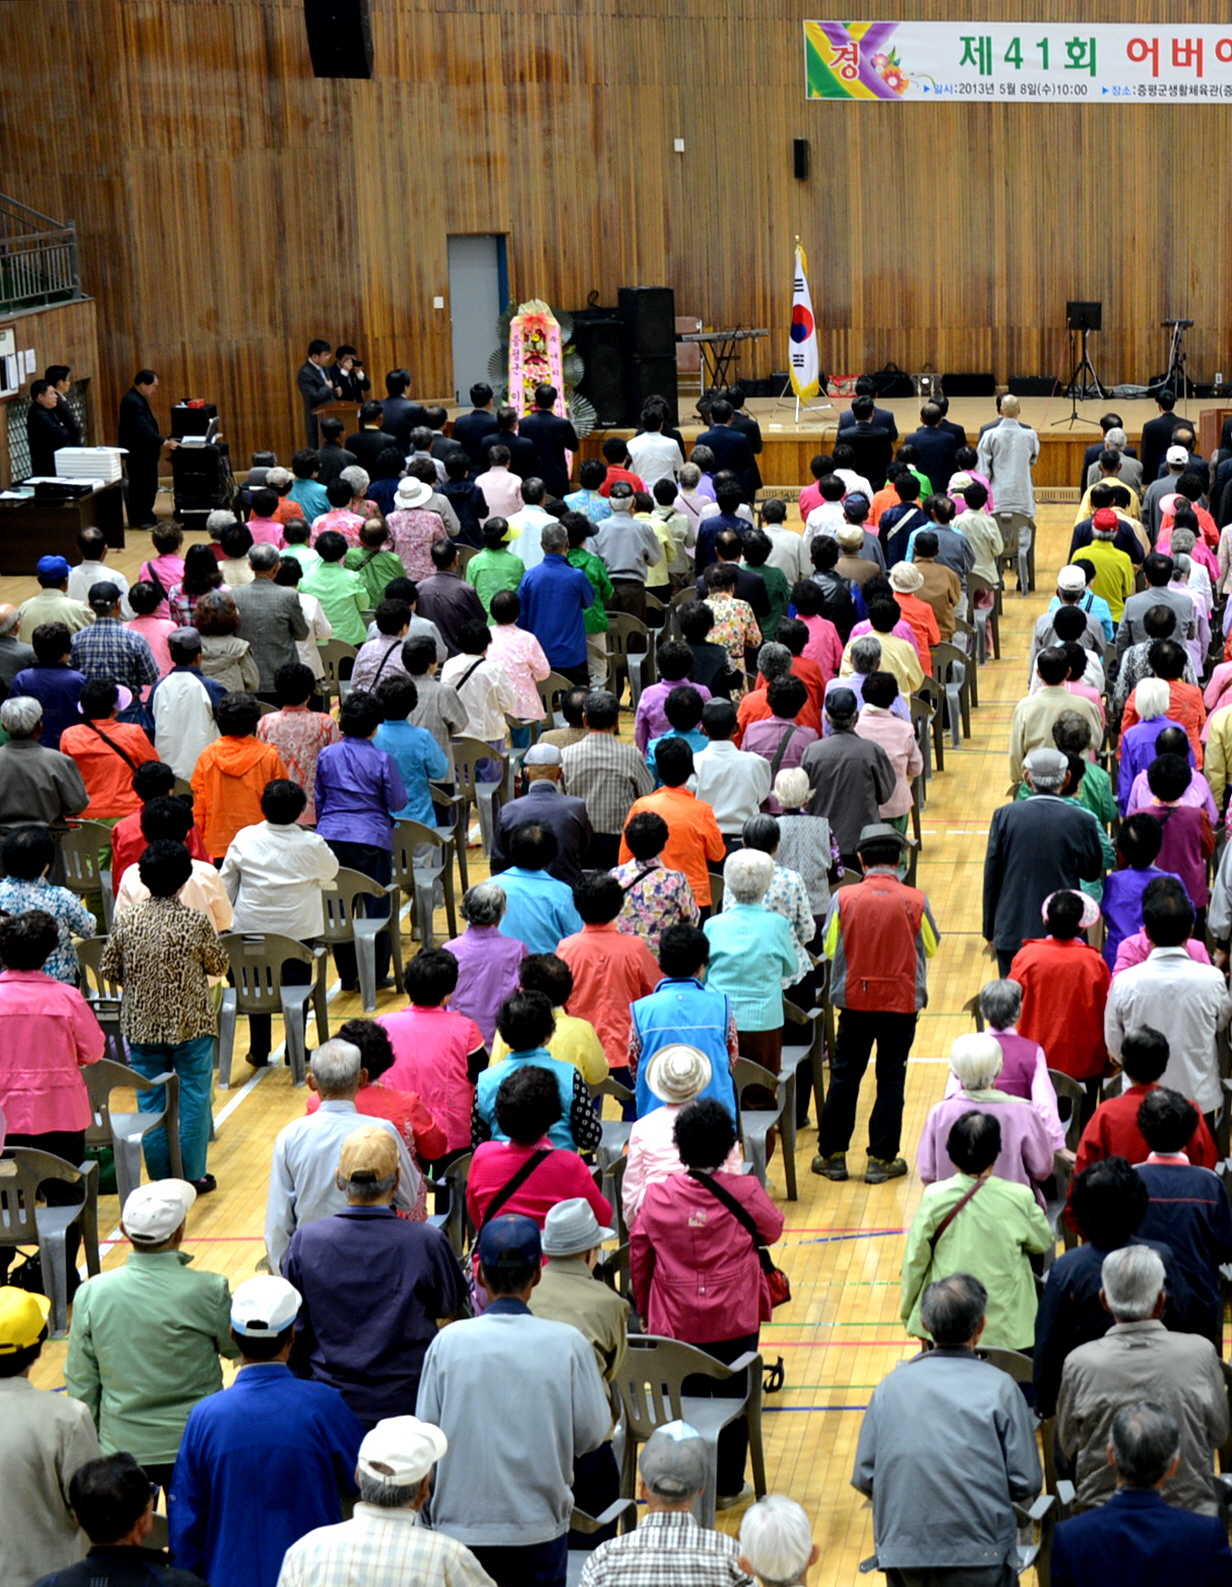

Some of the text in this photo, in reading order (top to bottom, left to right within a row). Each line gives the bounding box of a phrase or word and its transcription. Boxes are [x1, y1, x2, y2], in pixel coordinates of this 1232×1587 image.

[830, 42, 859, 80] 경
[959, 36, 1098, 77] 제41회
[999, 83, 1016, 95] 5월
